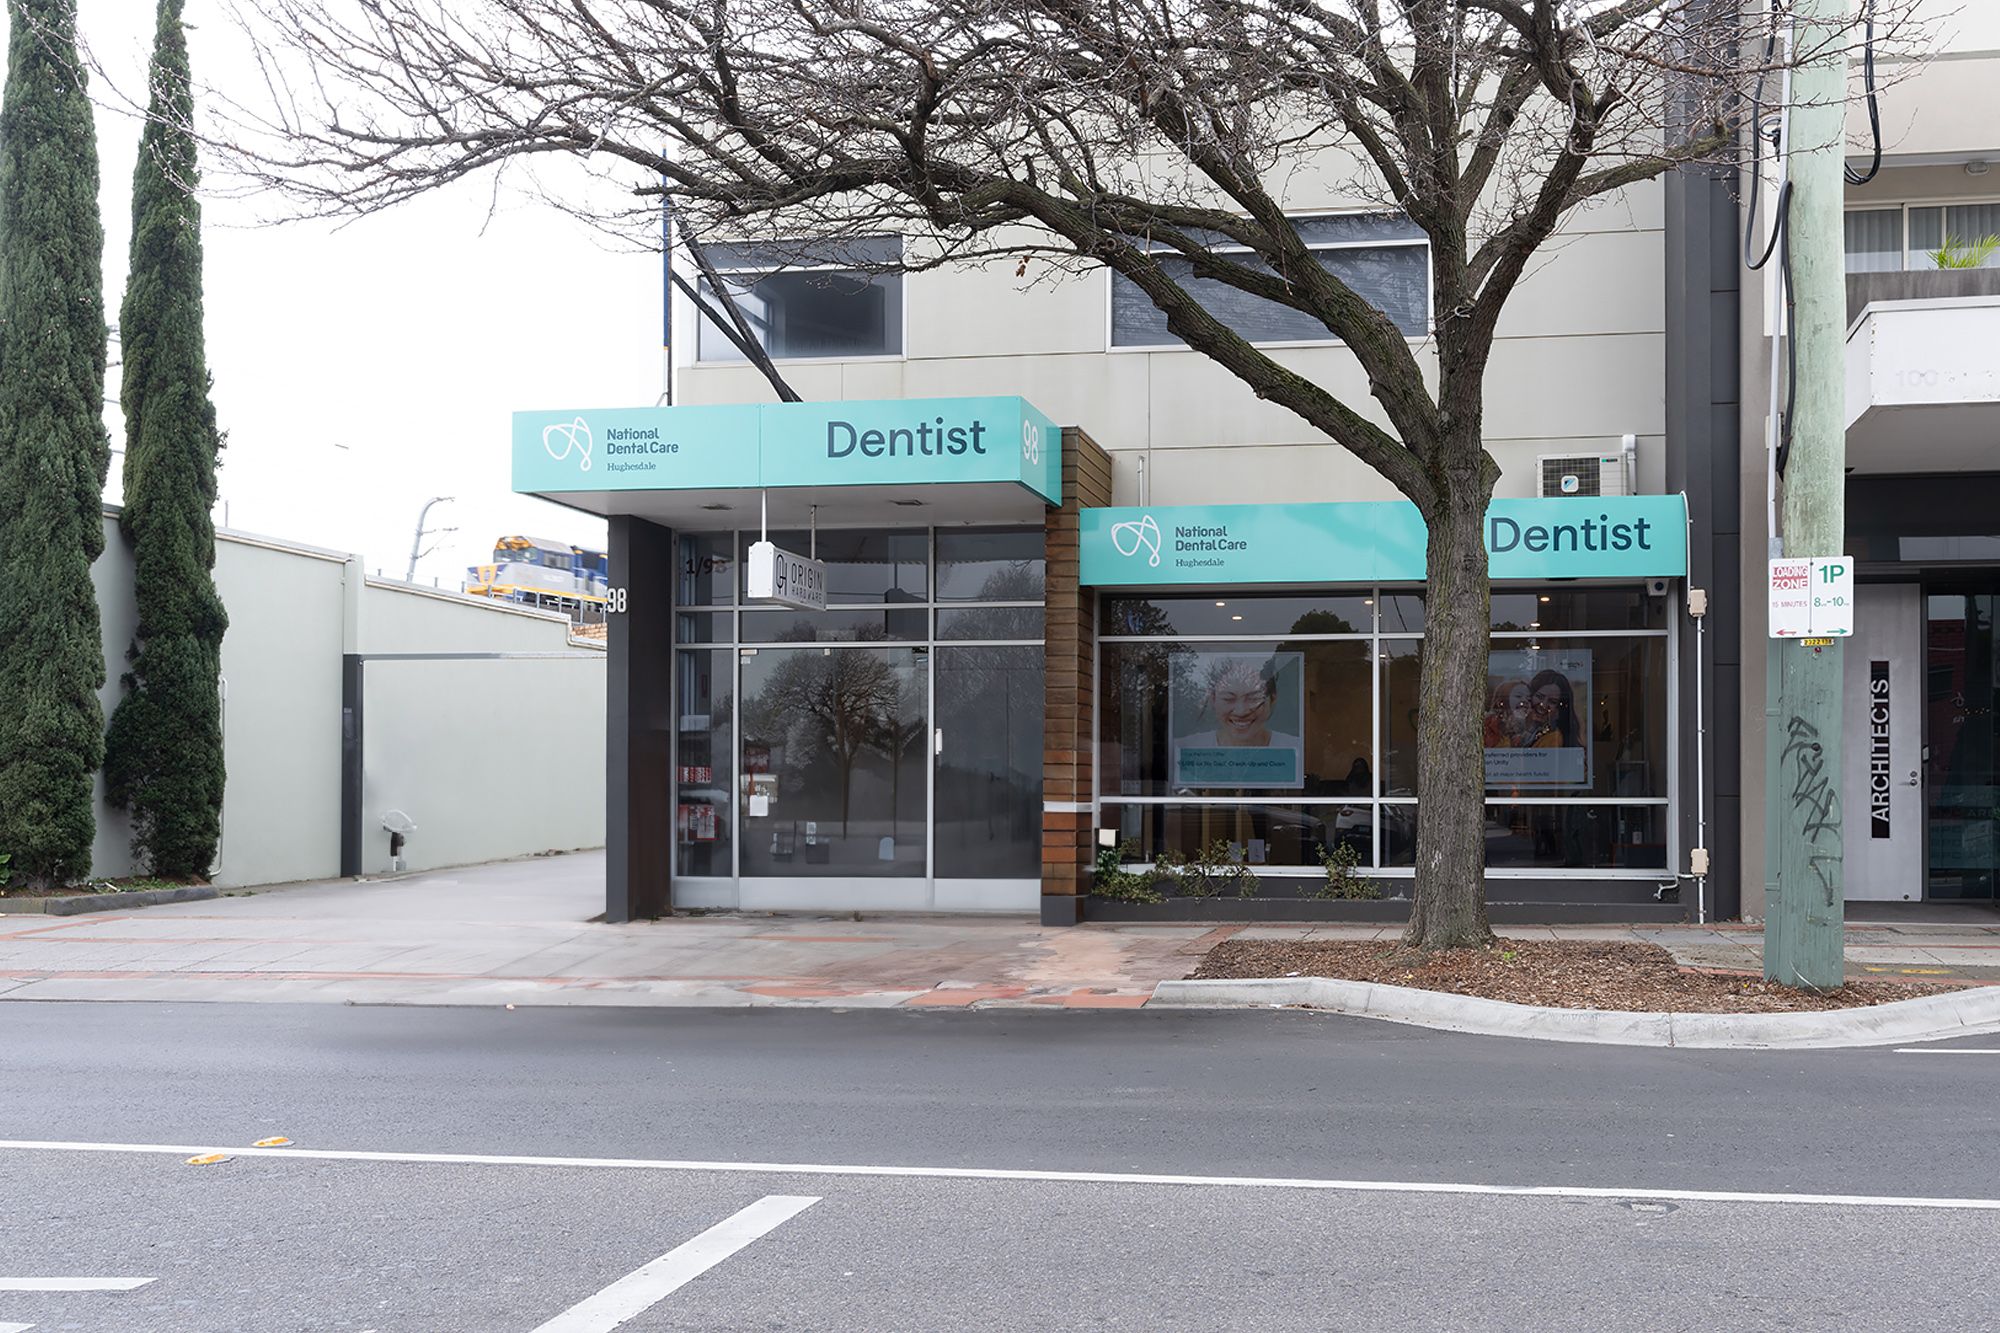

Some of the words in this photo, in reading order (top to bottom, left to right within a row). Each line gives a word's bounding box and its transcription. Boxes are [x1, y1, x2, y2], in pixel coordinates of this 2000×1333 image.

[607, 428, 659, 440] National
[828, 417, 986, 458] Dentist
[1023, 419, 1039, 465] 98
[607, 462, 656, 472] Hughesdale
[1176, 526, 1227, 538] National
[1491, 514, 1651, 553] Dentist
[1175, 558, 1224, 568] Hughesdale
[792, 563, 823, 591] ORIGIN
[1773, 566, 1808, 577] LOADING
[1818, 565, 1845, 583] 1P
[1773, 579, 1808, 589] ZONE
[607, 587, 627, 613] 98
[1781, 600, 1808, 608] MINUTES
[1871, 679, 1890, 822] ARCHITECTS
